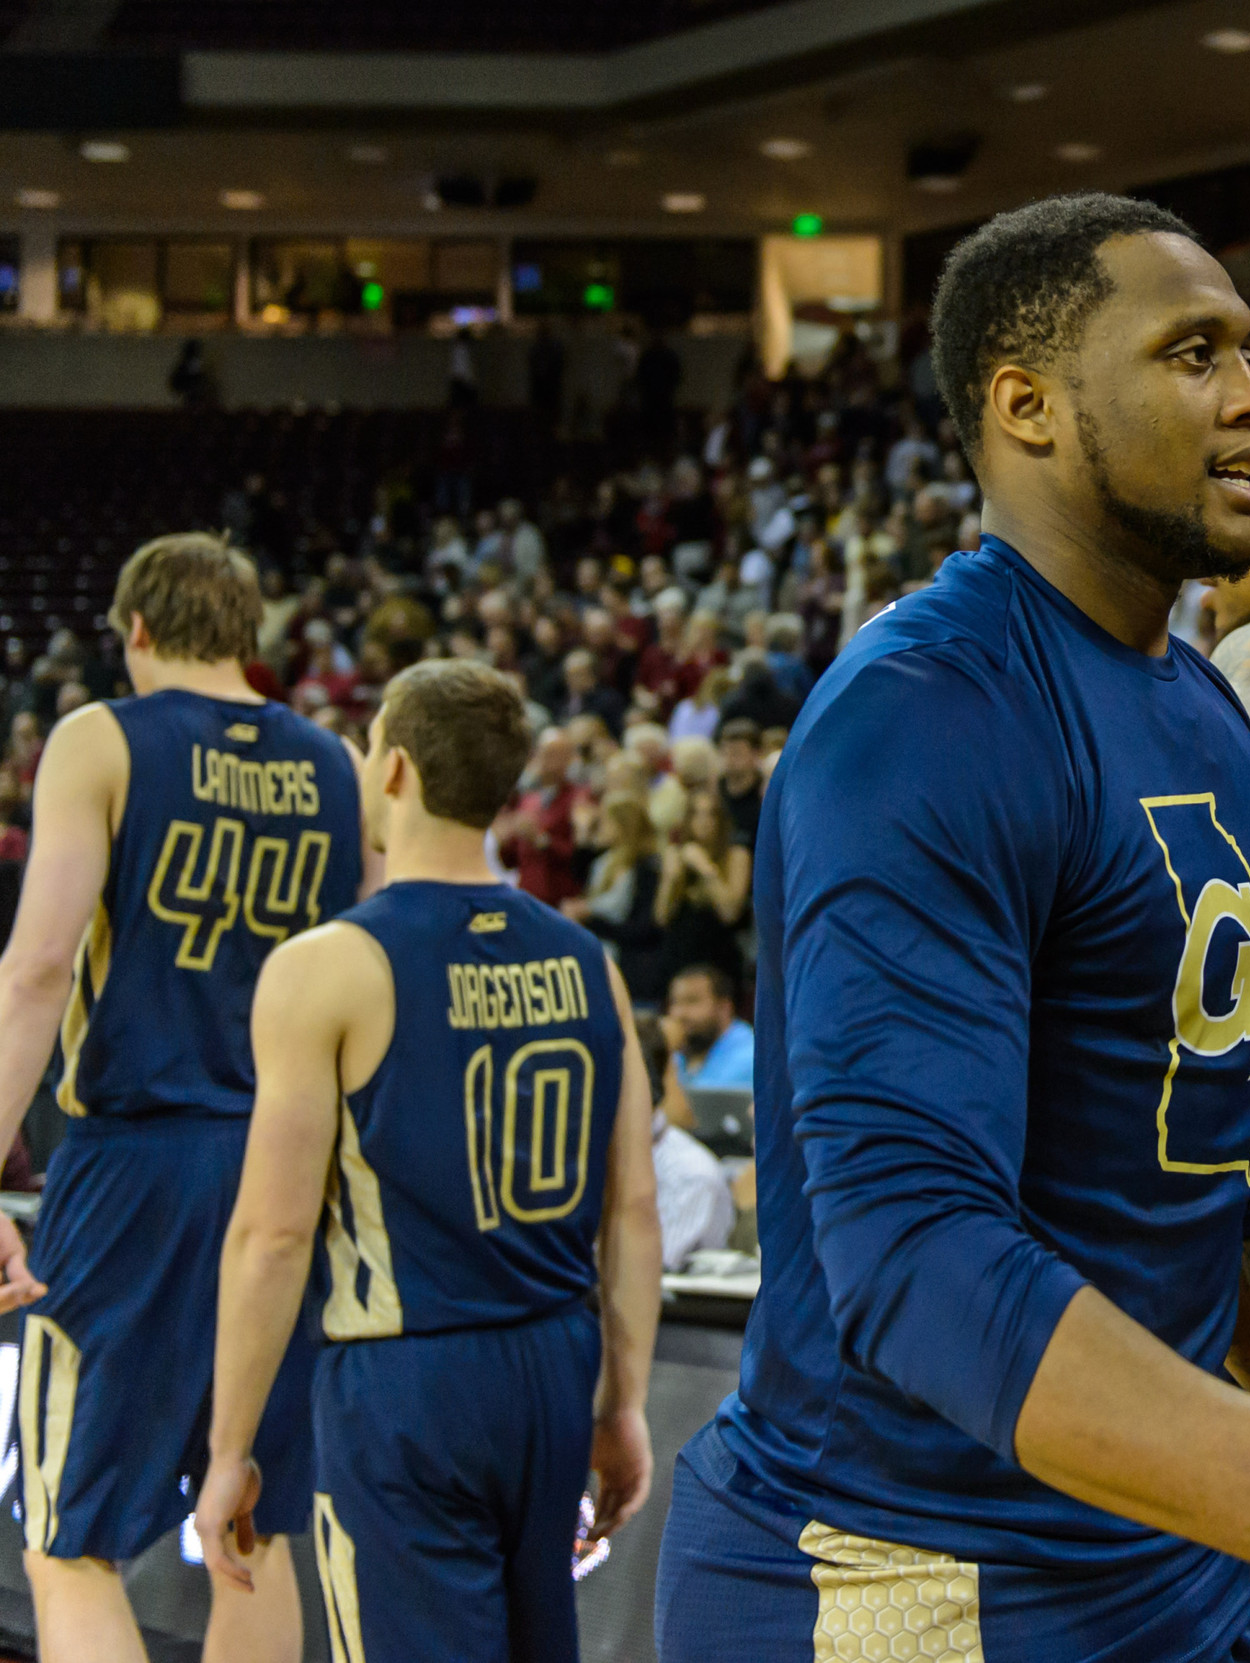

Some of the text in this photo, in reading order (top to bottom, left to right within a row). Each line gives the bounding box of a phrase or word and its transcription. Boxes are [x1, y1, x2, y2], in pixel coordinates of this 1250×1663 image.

[192, 744, 320, 816] LAMMERS
[148, 817, 331, 971] 44
[464, 1038, 595, 1231] 10
